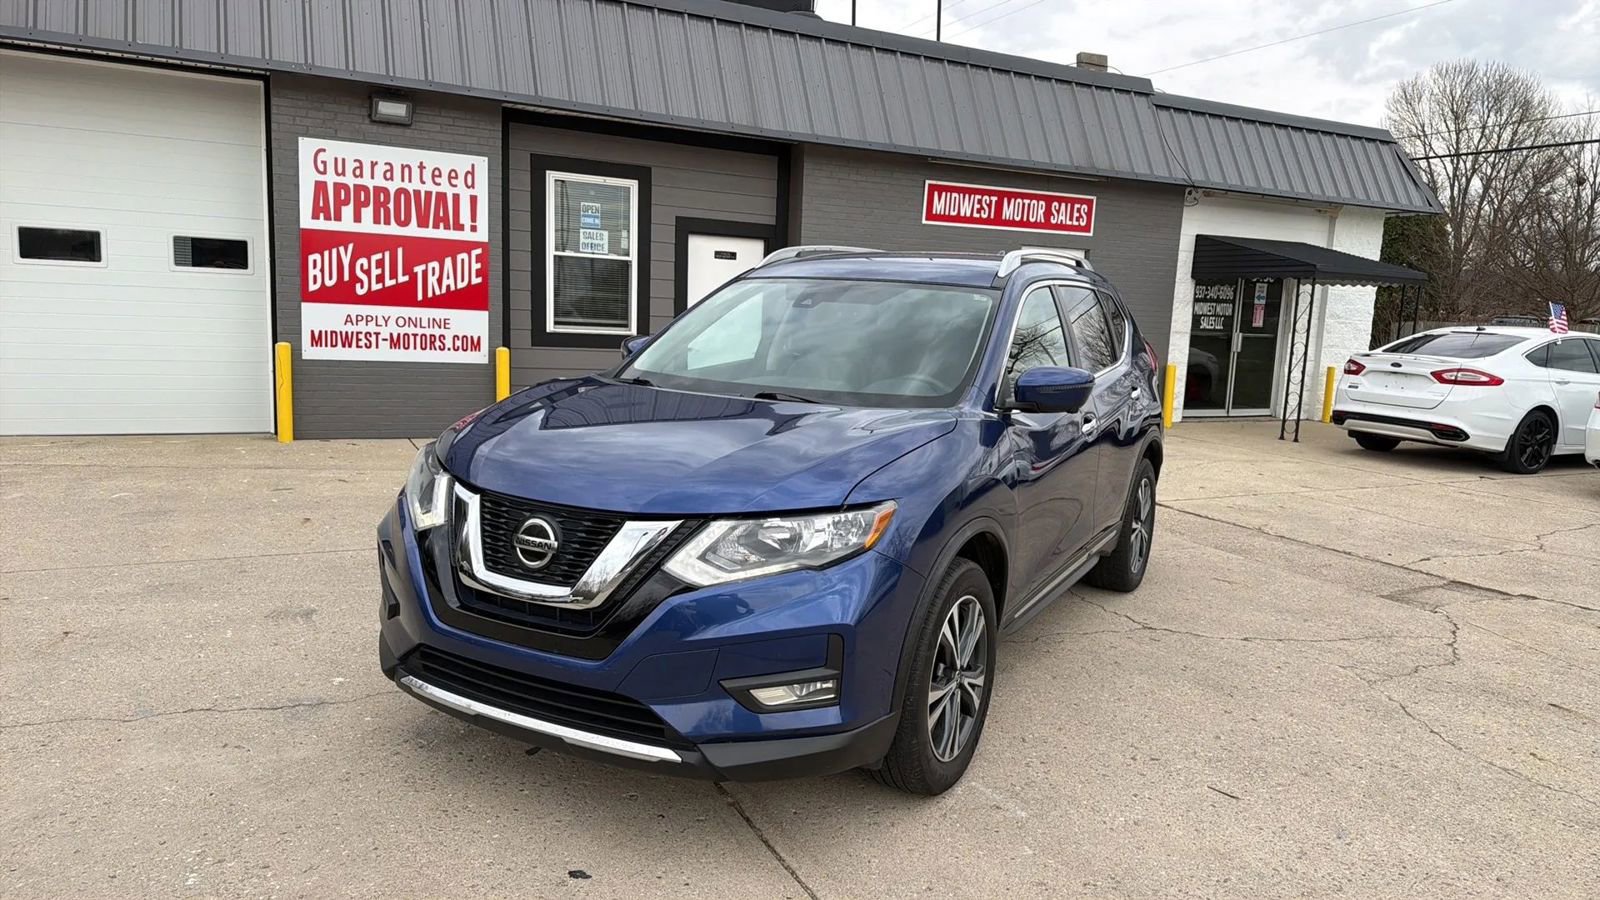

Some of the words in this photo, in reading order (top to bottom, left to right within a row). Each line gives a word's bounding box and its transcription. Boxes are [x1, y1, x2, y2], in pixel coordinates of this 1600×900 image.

[313, 148, 476, 189] Guaranteed
[311, 180, 478, 232] APPROVAL!
[582, 204, 599, 214] OPEN
[932, 191, 997, 219] MIDWEST
[1002, 197, 1046, 223] MOTOR
[1050, 201, 1088, 226] SALES
[582, 231, 604, 241] SALES
[581, 242, 605, 251] OFFICE
[307, 243, 354, 292] BUY
[355, 247, 410, 296] SELL
[413, 248, 483, 301] TRADE
[1194, 302, 1216, 316] MIDWEST
[1216, 303, 1233, 316] MOTOR
[344, 314, 392, 327] APPLY
[395, 316, 451, 330] ONLINE
[1200, 316, 1215, 329] SALES
[1215, 316, 1224, 329] LLC
[310, 330, 481, 352] MIDWEST-MOTORS.COM
[516, 537, 551, 549] NISSAN
